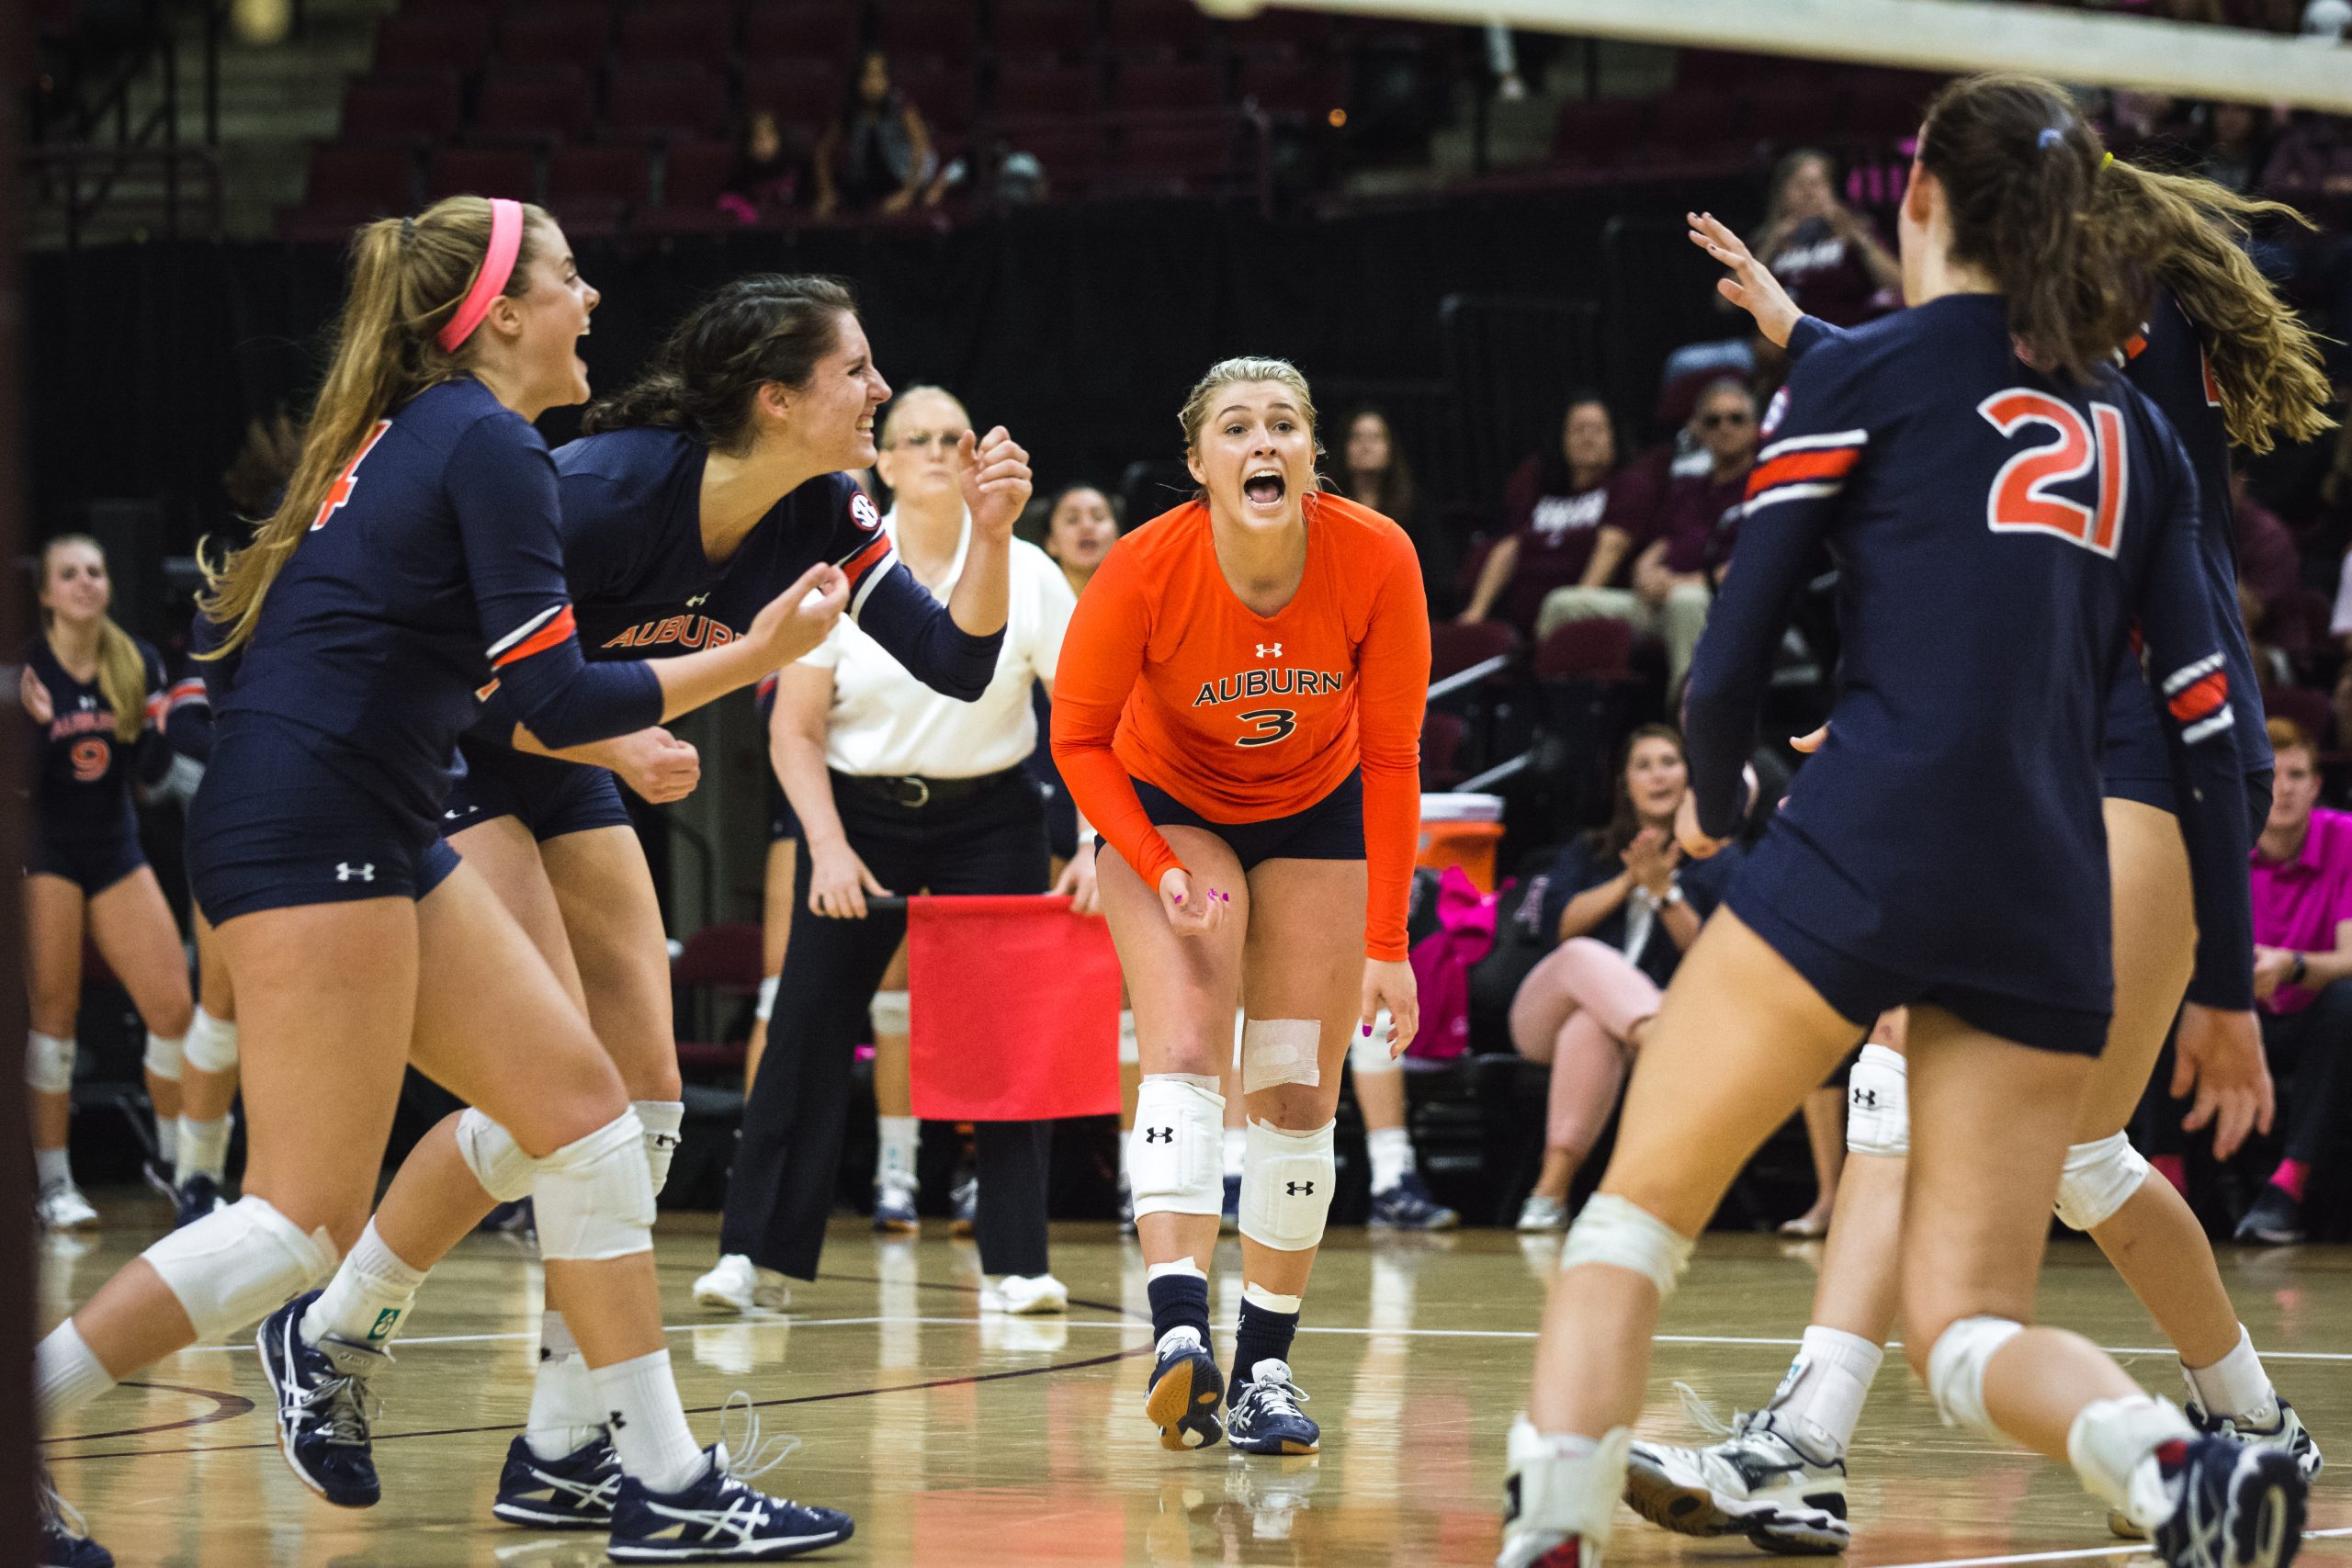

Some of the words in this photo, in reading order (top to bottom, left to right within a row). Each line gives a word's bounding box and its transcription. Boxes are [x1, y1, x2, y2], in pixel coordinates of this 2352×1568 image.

[1976, 387, 2129, 559] 21
[600, 614, 747, 651] AUBUR
[1192, 668, 1343, 706] AUBURN
[1235, 708, 1297, 748] 3
[71, 737, 111, 781] 9
